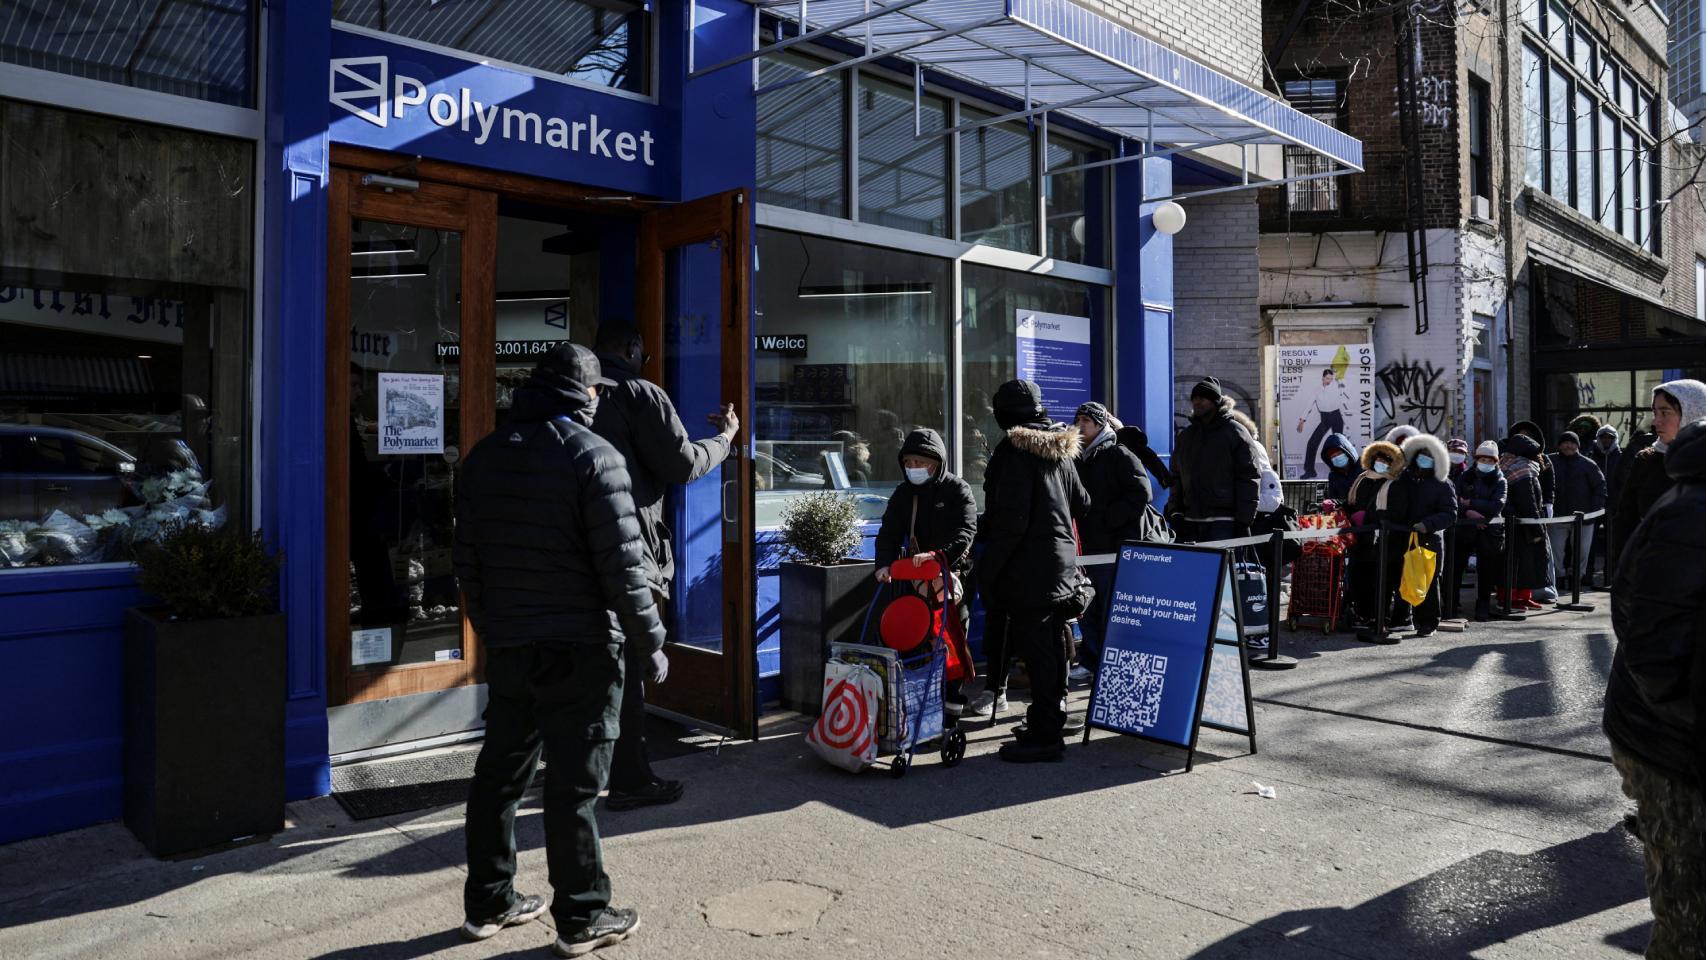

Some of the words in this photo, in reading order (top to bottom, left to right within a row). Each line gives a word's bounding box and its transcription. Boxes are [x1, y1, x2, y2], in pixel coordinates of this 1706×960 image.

[394, 74, 655, 166] Polymarket
[1031, 319, 1061, 331] Polymarket
[761, 336, 805, 349] Welco
[437, 343, 459, 356] lym
[1282, 366, 1303, 374] LESS
[1359, 348, 1371, 384] SOFIE
[1360, 391, 1371, 440] PAVITT
[383, 425, 402, 436] The
[383, 436, 439, 450] Polymarket
[1133, 551, 1172, 563] Polymarket
[1116, 591, 1133, 601] Take
[1134, 594, 1155, 605] what
[1156, 598, 1172, 607] you
[1173, 600, 1197, 611] need,
[1112, 603, 1130, 613] pick
[1131, 606, 1152, 616] what
[1152, 609, 1172, 620] your
[1173, 612, 1196, 622] heart
[1110, 614, 1142, 627] desires.
